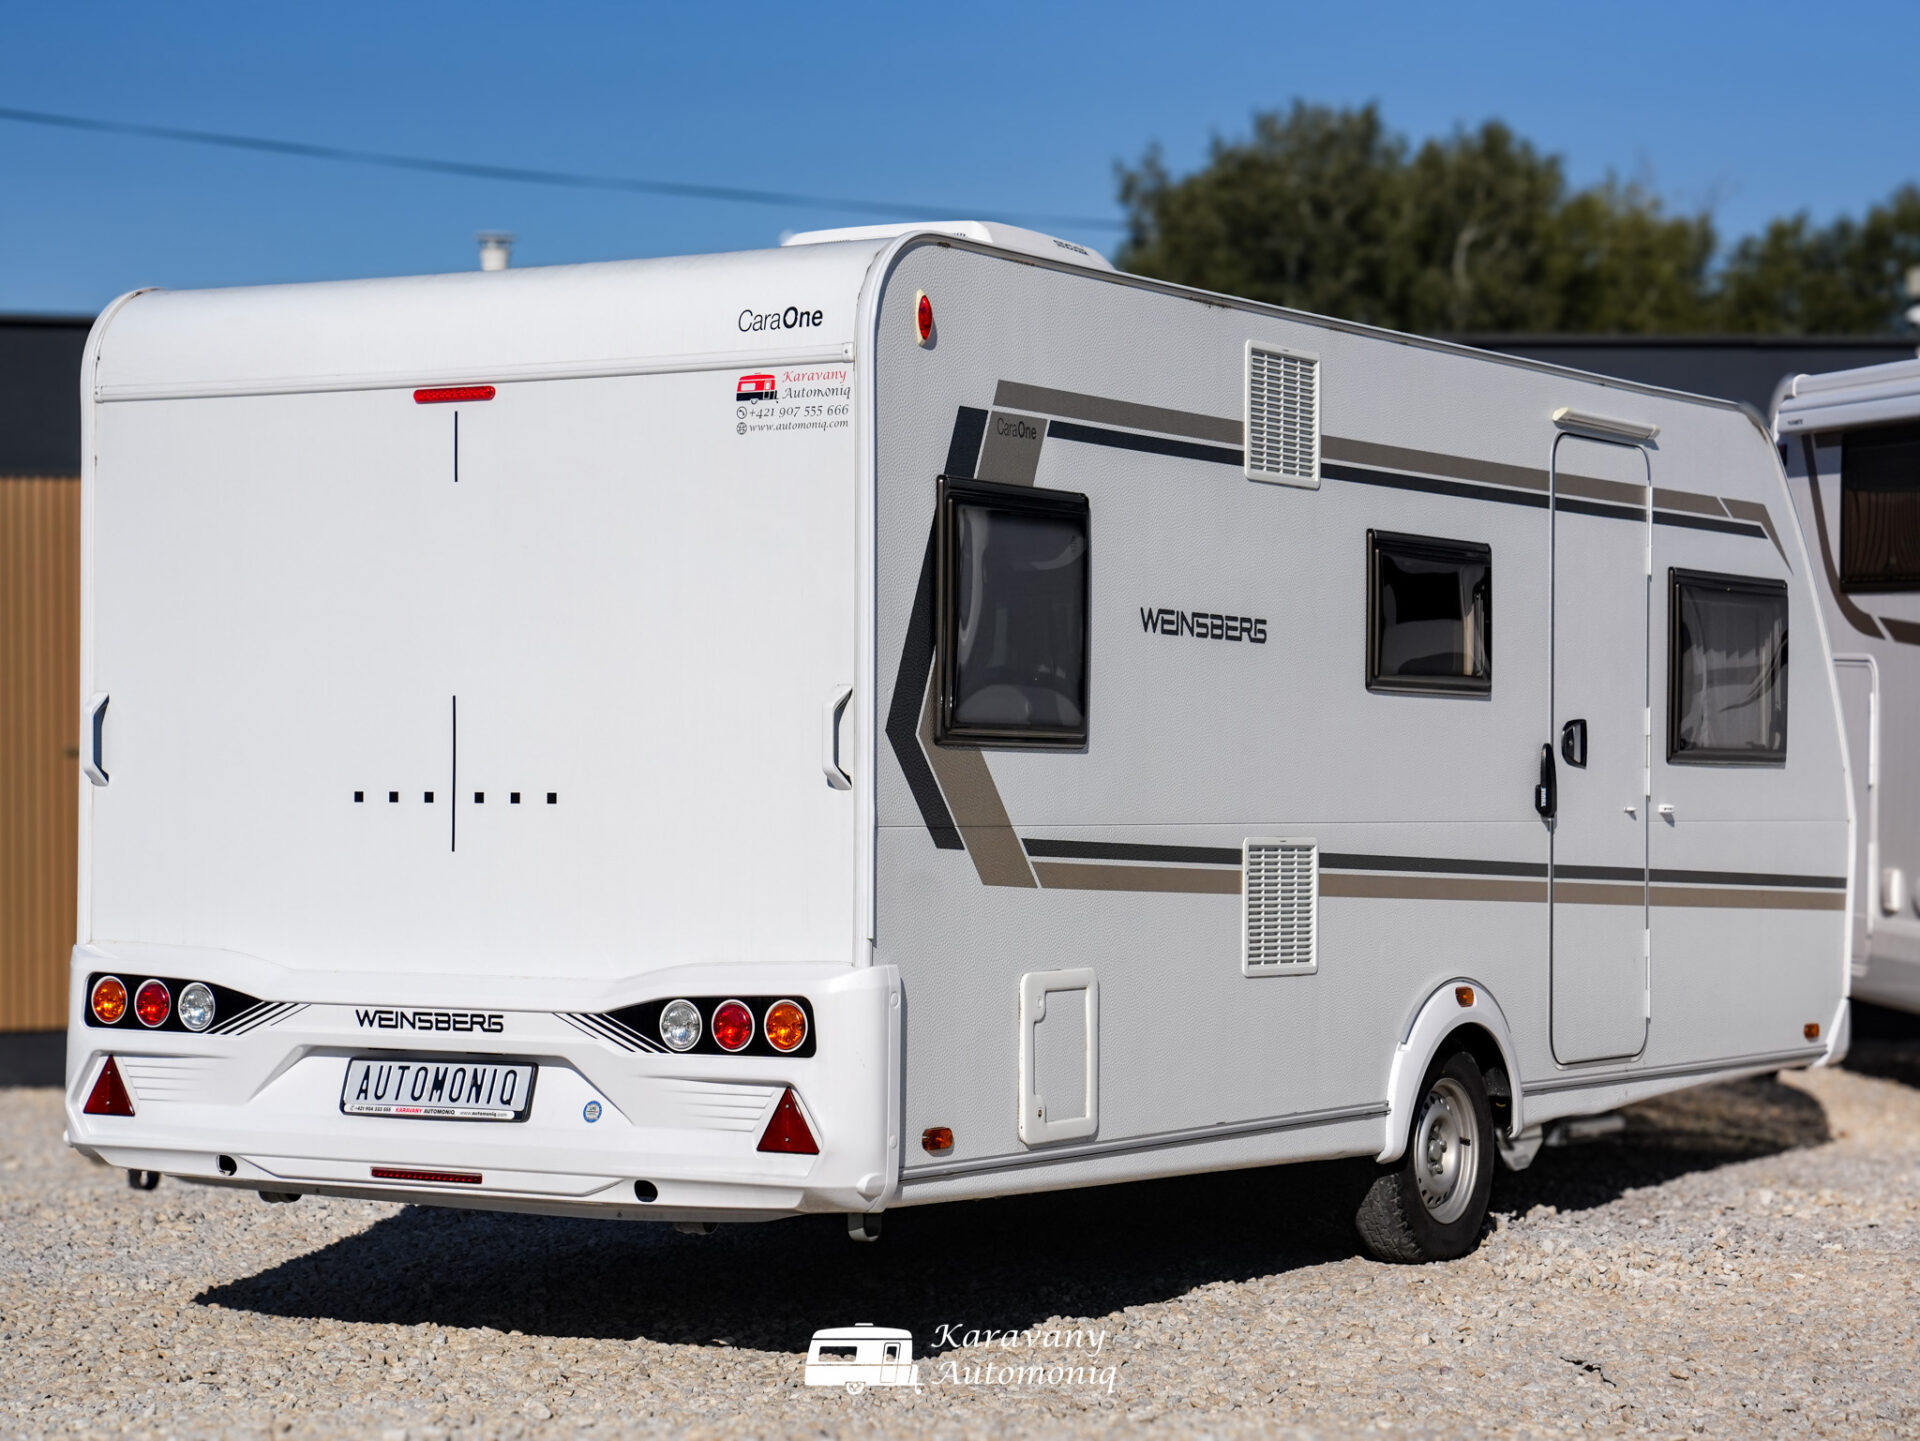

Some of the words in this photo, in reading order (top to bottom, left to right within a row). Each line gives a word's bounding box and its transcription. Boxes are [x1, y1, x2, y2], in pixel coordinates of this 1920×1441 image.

[738, 306, 823, 332] CaraOne
[782, 370, 847, 384] Karavany
[782, 386, 851, 399] Automoniq
[750, 407, 774, 419] +421
[779, 406, 800, 418] 907
[804, 405, 823, 417] 555
[827, 404, 849, 416] 666
[749, 419, 849, 432] www.automoniq.com
[997, 417, 1037, 440] CaraOne
[1140, 607, 1268, 644] WEINSBERG
[355, 1009, 505, 1033] WEINSBERG
[356, 1065, 518, 1106] AUTOMONIQ
